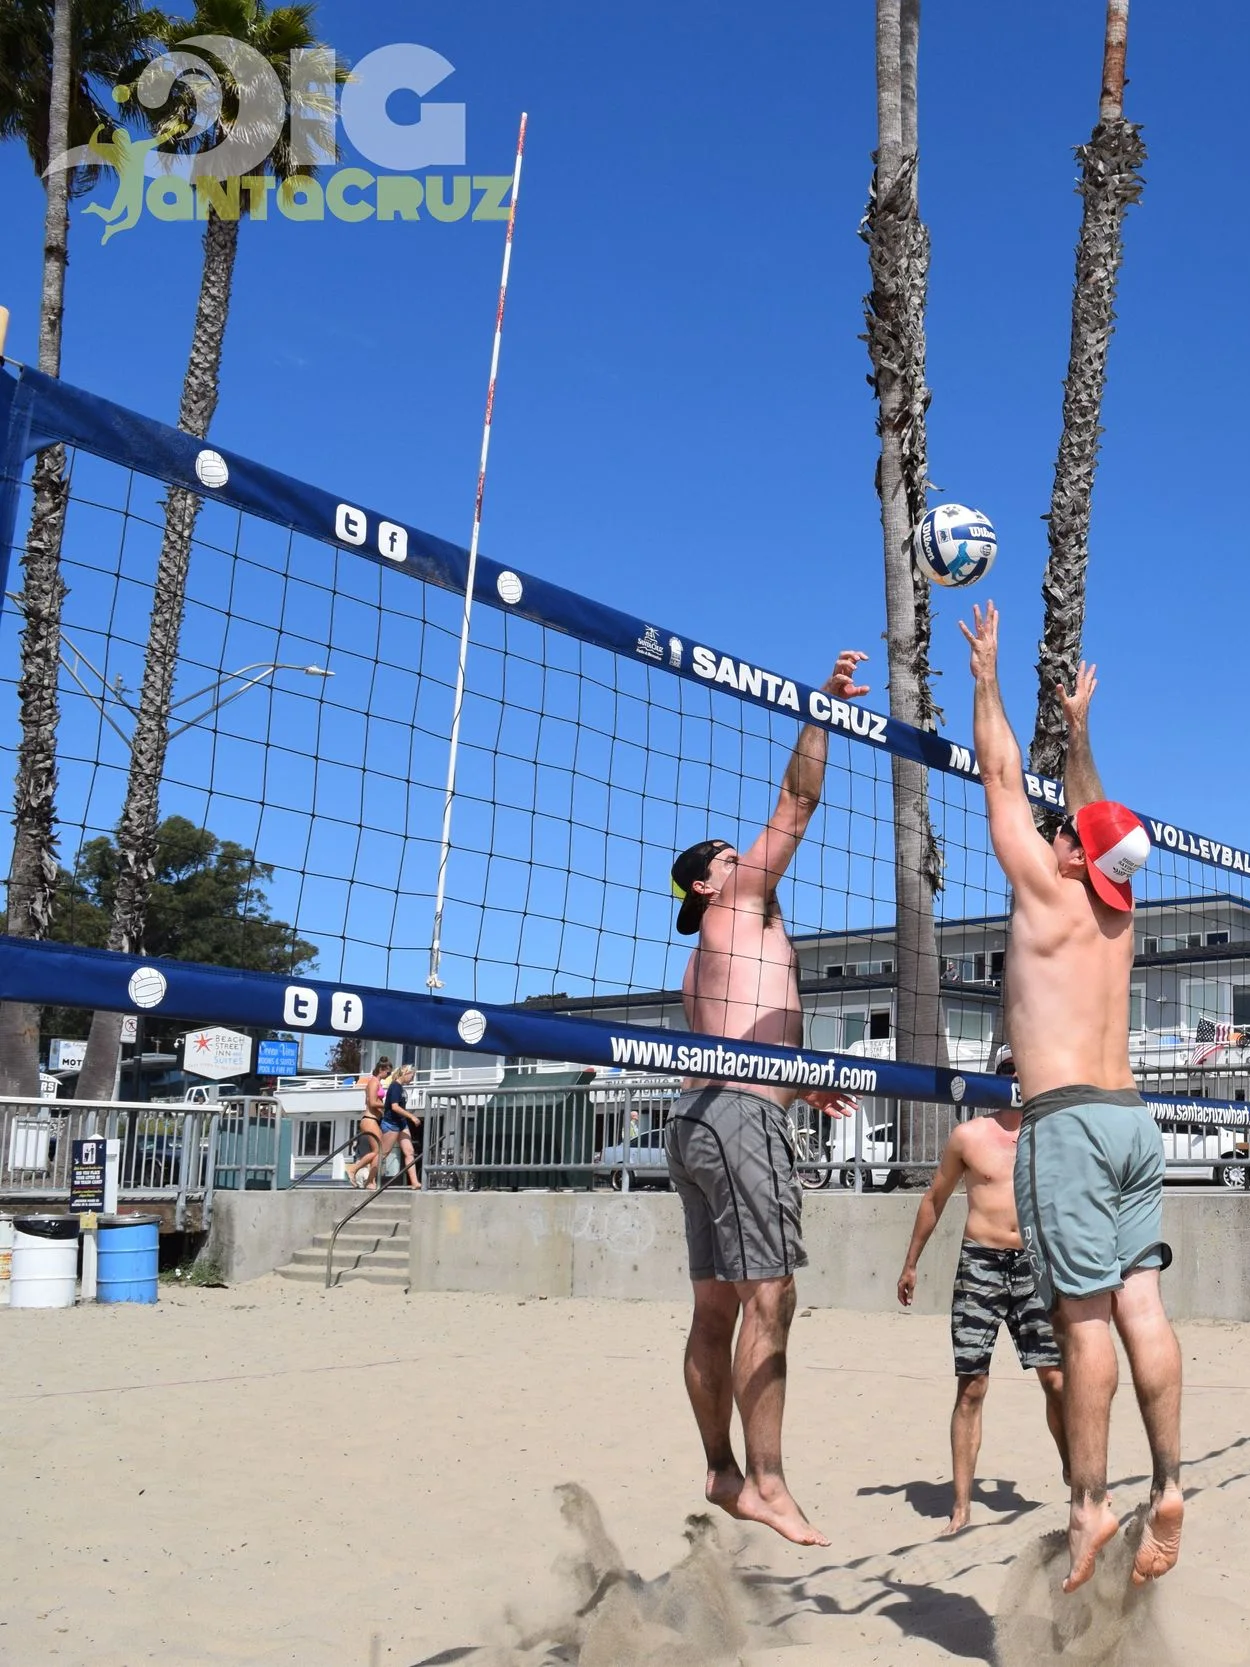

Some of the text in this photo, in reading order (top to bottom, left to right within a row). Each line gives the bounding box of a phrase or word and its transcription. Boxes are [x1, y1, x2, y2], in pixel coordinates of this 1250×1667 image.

[921, 519, 935, 561] Wilson
[692, 646, 887, 743] SANTA CRUZ
[62, 1059, 82, 1067] MOT
[215, 1035, 245, 1043] BEACH
[610, 1037, 877, 1091] www.santacruzwharf.com
[1023, 1226, 1043, 1281] RVCA
